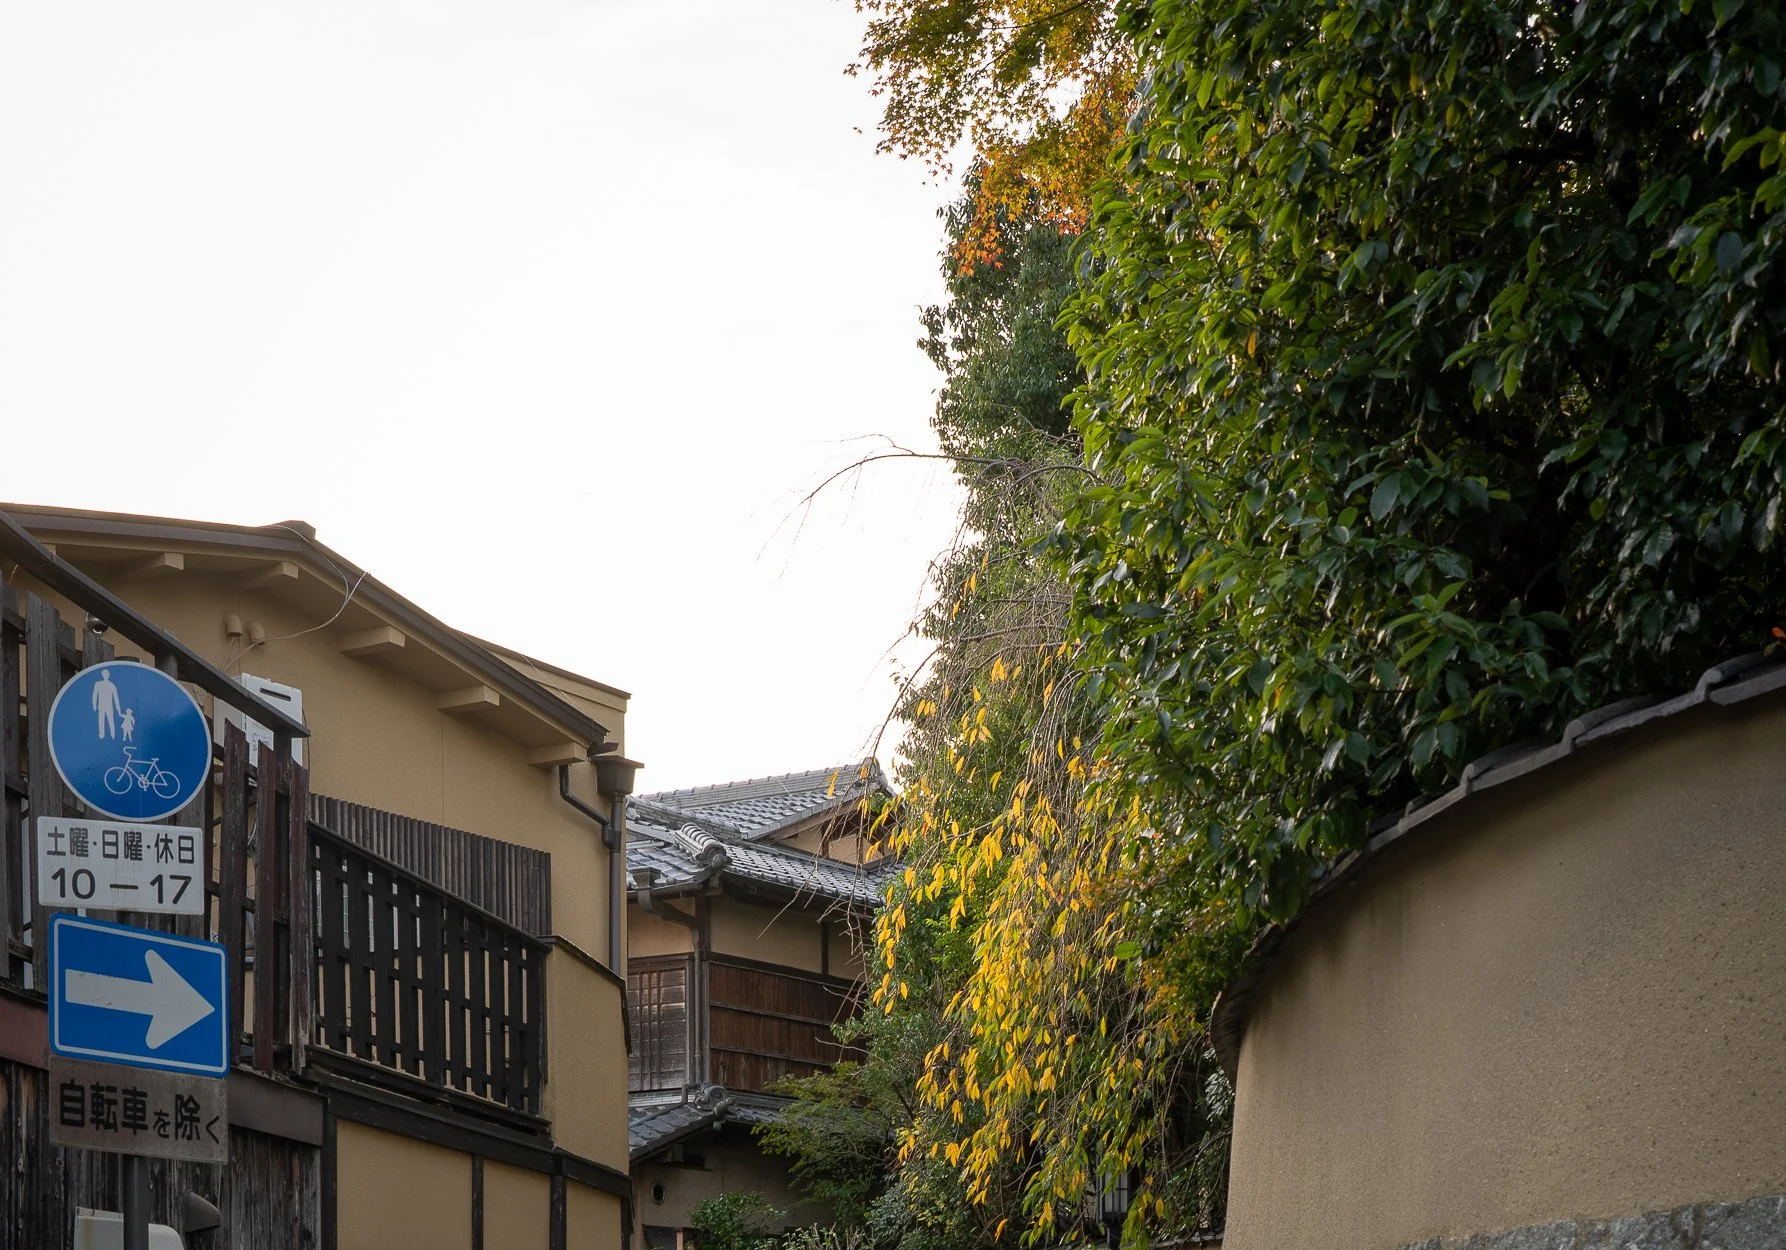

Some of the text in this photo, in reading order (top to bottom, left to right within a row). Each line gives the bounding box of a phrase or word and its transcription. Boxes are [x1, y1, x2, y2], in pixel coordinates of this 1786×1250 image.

[60, 1079, 220, 1144] 自転車を除く
